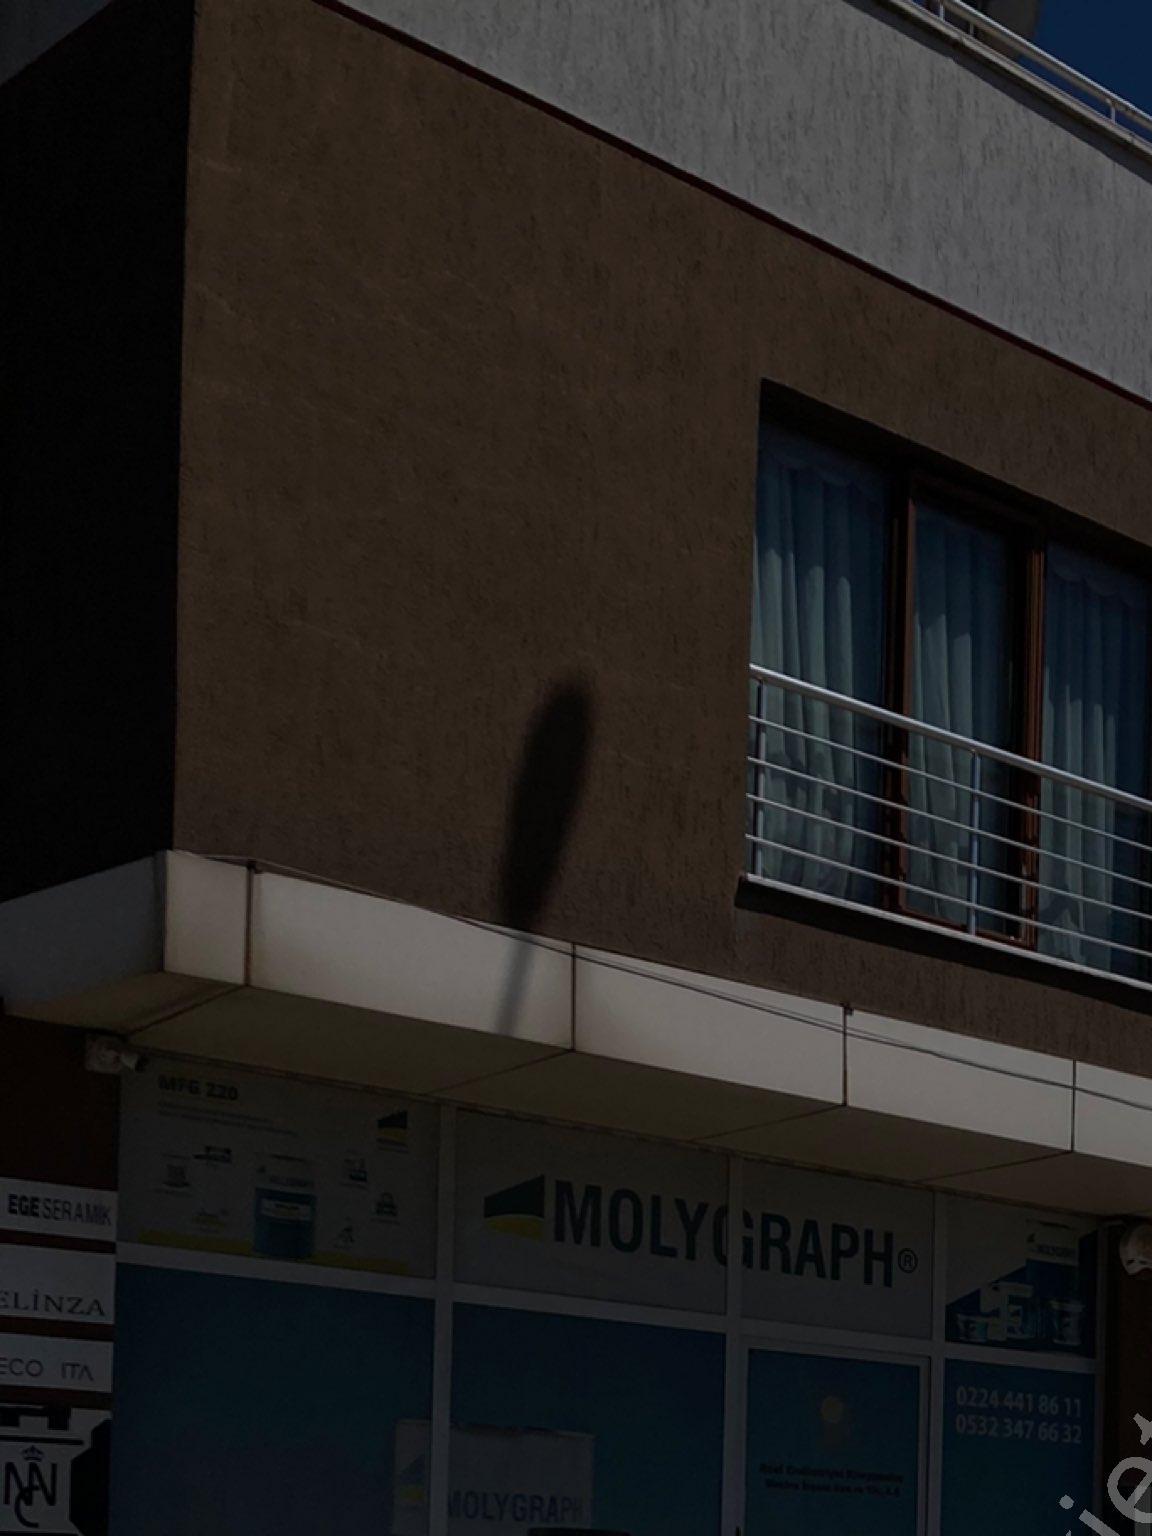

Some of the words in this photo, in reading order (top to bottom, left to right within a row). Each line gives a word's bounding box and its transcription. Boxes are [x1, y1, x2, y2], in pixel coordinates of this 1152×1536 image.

[8, 1193, 40, 1217] EGE
[956, 1385, 1001, 1409] 0224
[1003, 1389, 1034, 1414] 441
[1038, 1394, 1059, 1416] 86
[1064, 1397, 1081, 1419] 11
[955, 1413, 1000, 1438] 0532
[1002, 1417, 1034, 1440] 347
[1063, 1424, 1081, 1446] 32
